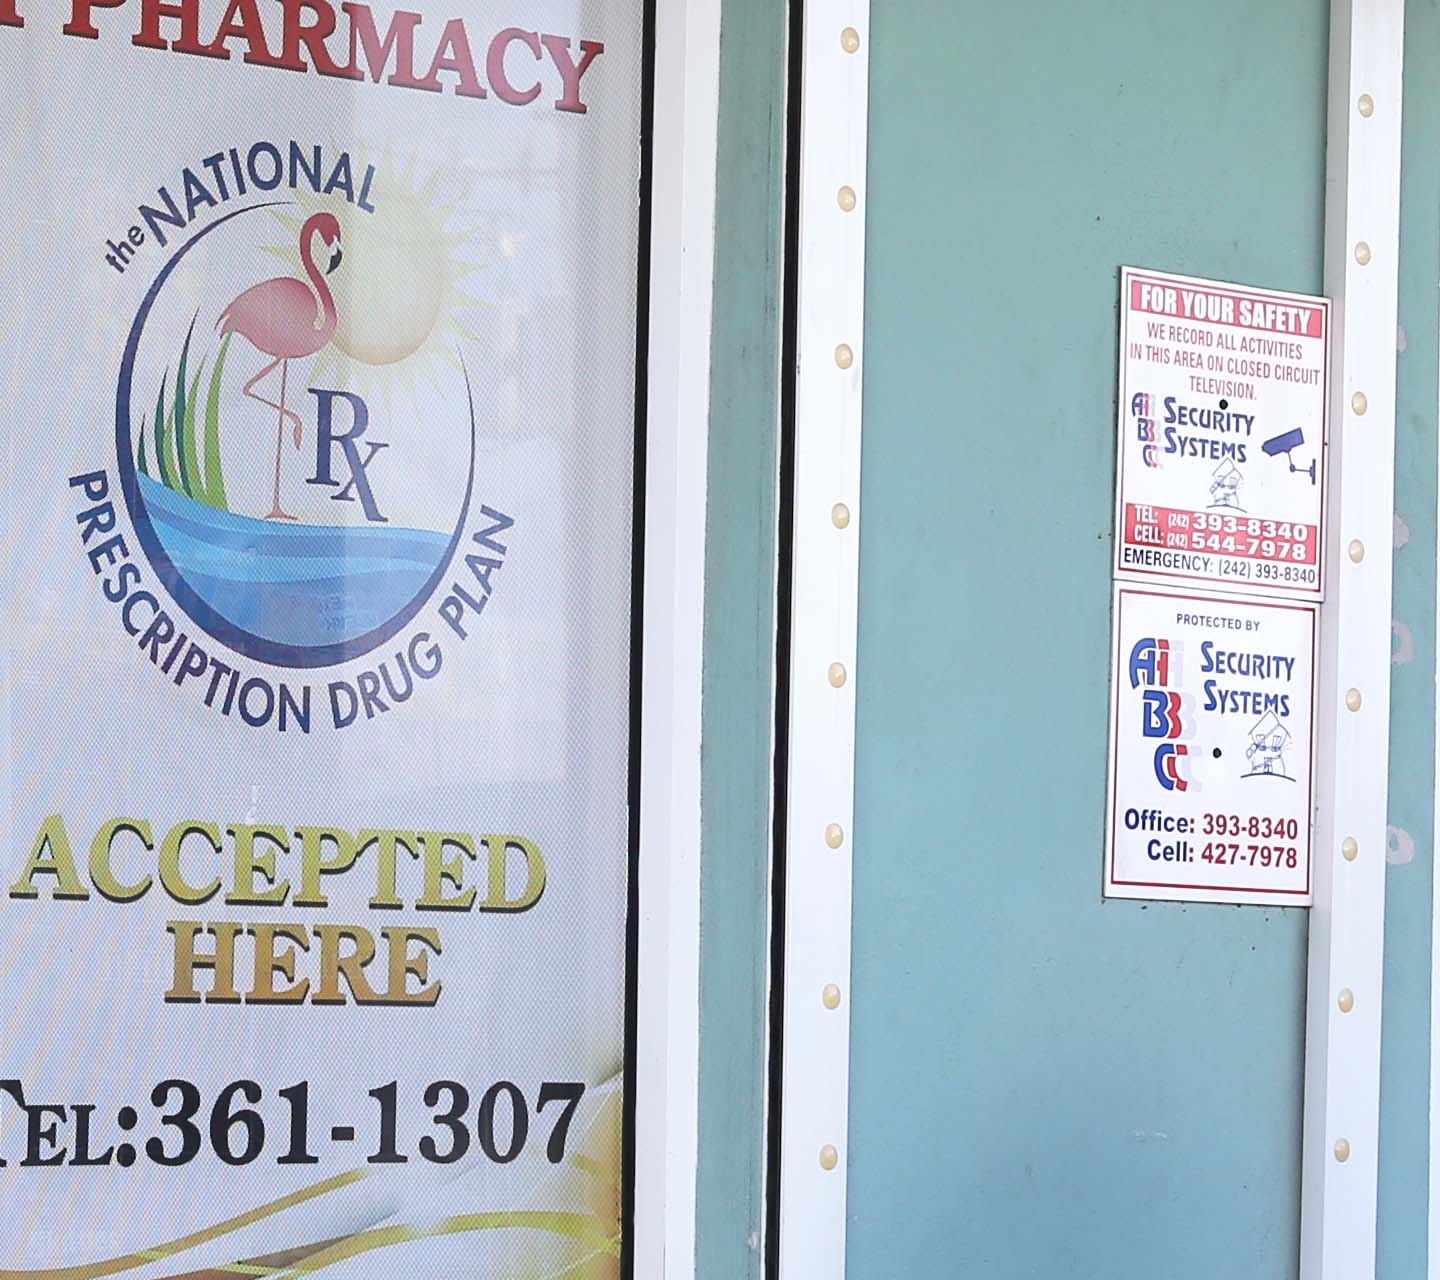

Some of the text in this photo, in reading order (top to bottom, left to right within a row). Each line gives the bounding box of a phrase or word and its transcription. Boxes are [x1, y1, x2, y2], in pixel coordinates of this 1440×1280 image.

[105, 140, 375, 274] the NATIONAL
[1139, 283, 1312, 335] FOR YOUR SAFETY
[1147, 322, 1303, 360] WE RECORD ALL ACTIVITIES
[1130, 343, 1321, 386] IN THIS AREA ON CLOSED CIRCUIT
[1188, 374, 1258, 401] TELEVISION.
[1164, 396, 1256, 437] SECURITY
[1164, 426, 1248, 464] SYSTEMS
[1134, 504, 1308, 542] TEL: (242) 393-8340
[1134, 524, 1307, 562] CELL: (242) 544-7978
[1124, 547, 1316, 585] EMERGENCY: (242) 393-8340
[68, 469, 515, 734] PRESCRIPTION DRUG PLAN
[1176, 613, 1260, 632] PROTECTED BY
[1200, 641, 1296, 682] SECURITY
[1203, 678, 1290, 717] SYSTEMS
[1124, 807, 1299, 840] Office: 393-8340
[9, 813, 547, 914] ACCEPTED
[1146, 838, 1298, 869] Cell: 427-7978
[163, 920, 443, 1007] HERE
